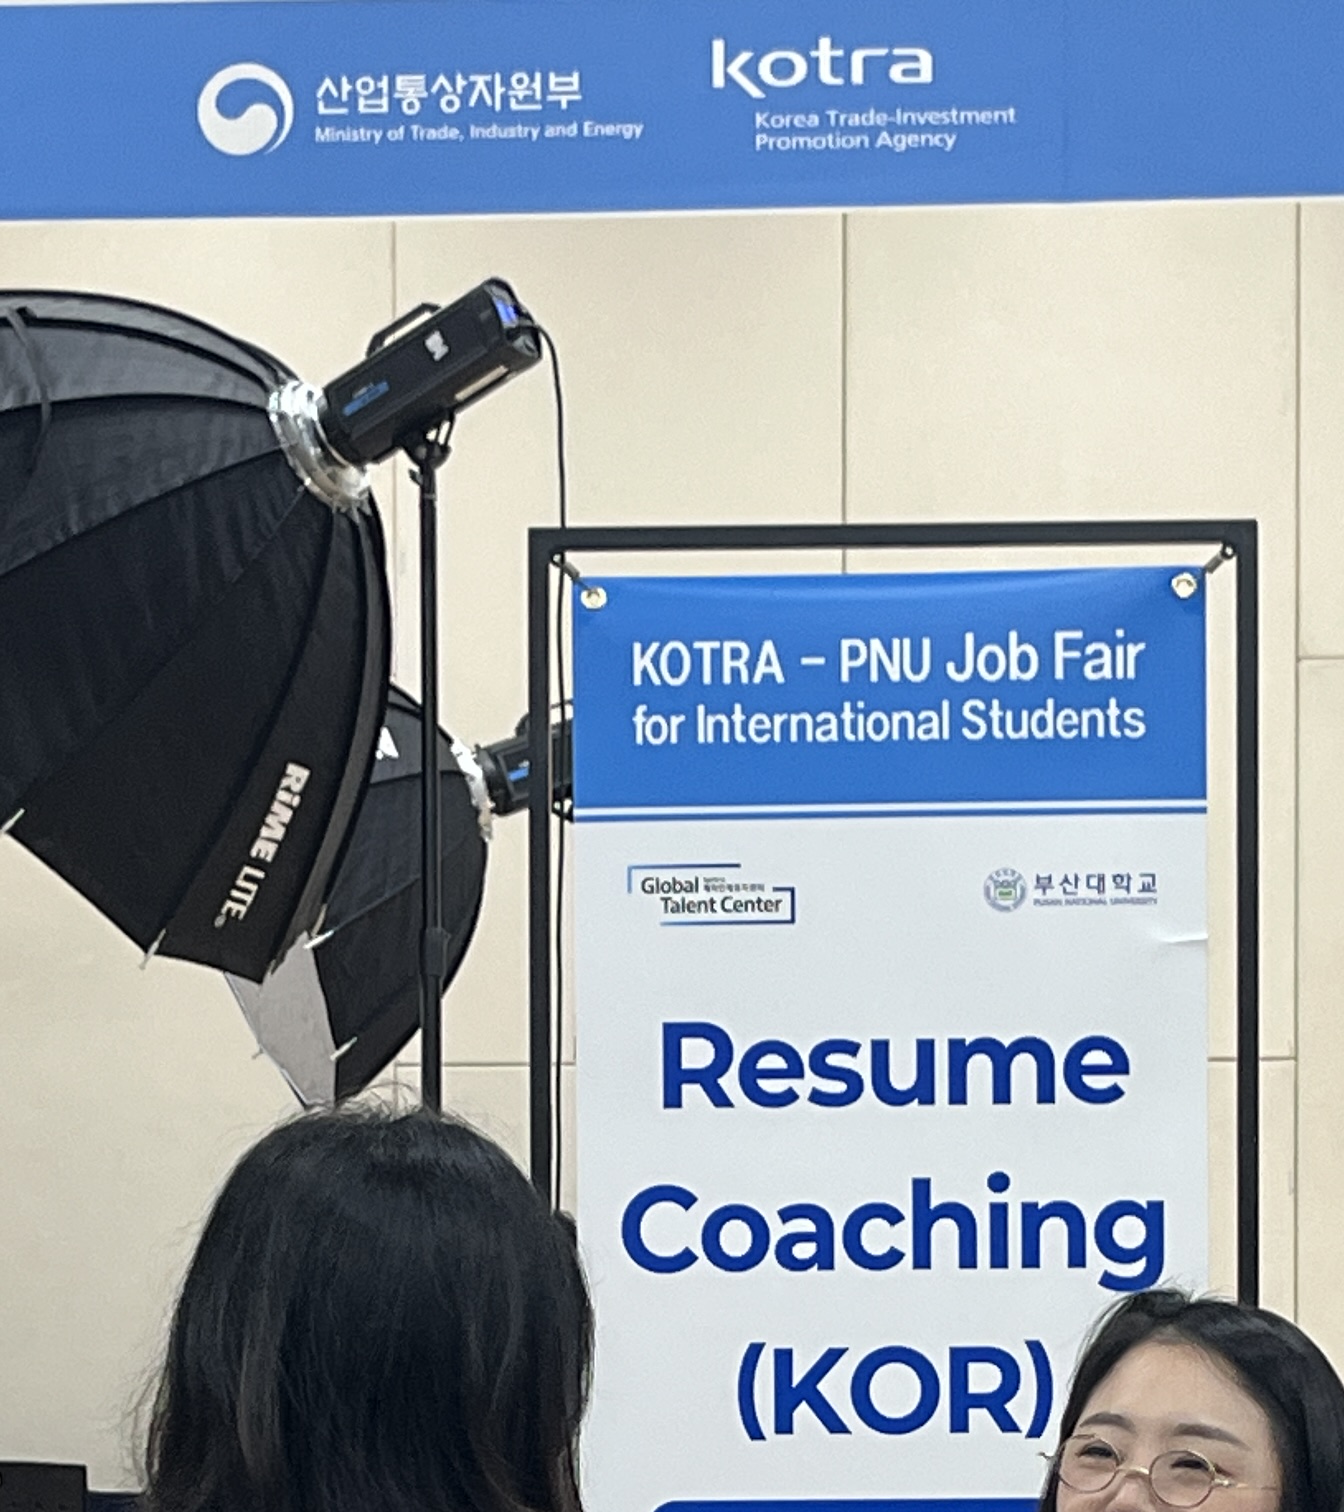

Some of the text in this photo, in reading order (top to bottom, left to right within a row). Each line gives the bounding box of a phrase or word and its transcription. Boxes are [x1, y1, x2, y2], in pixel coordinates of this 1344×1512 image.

[711, 35, 934, 98] kotra
[316, 71, 582, 115] 산업통상자원부
[315, 120, 644, 144] Ministry of Trade, Industry and Energy
[755, 107, 1016, 130] Korea Trade-Investment
[755, 130, 957, 152] Promotion Agency
[631, 640, 785, 687] KOTRA
[840, 637, 931, 684] PNU
[946, 630, 1039, 683] Job
[1055, 629, 1147, 680] Fair
[632, 697, 1147, 746] for International Students
[641, 876, 699, 895] Global
[660, 895, 783, 914] Talent Center
[1033, 872, 1158, 896] 부산대학교
[662, 1021, 1130, 1109] Resume
[621, 1172, 1166, 1292] Coaching
[737, 1339, 1054, 1441] (KOR)
